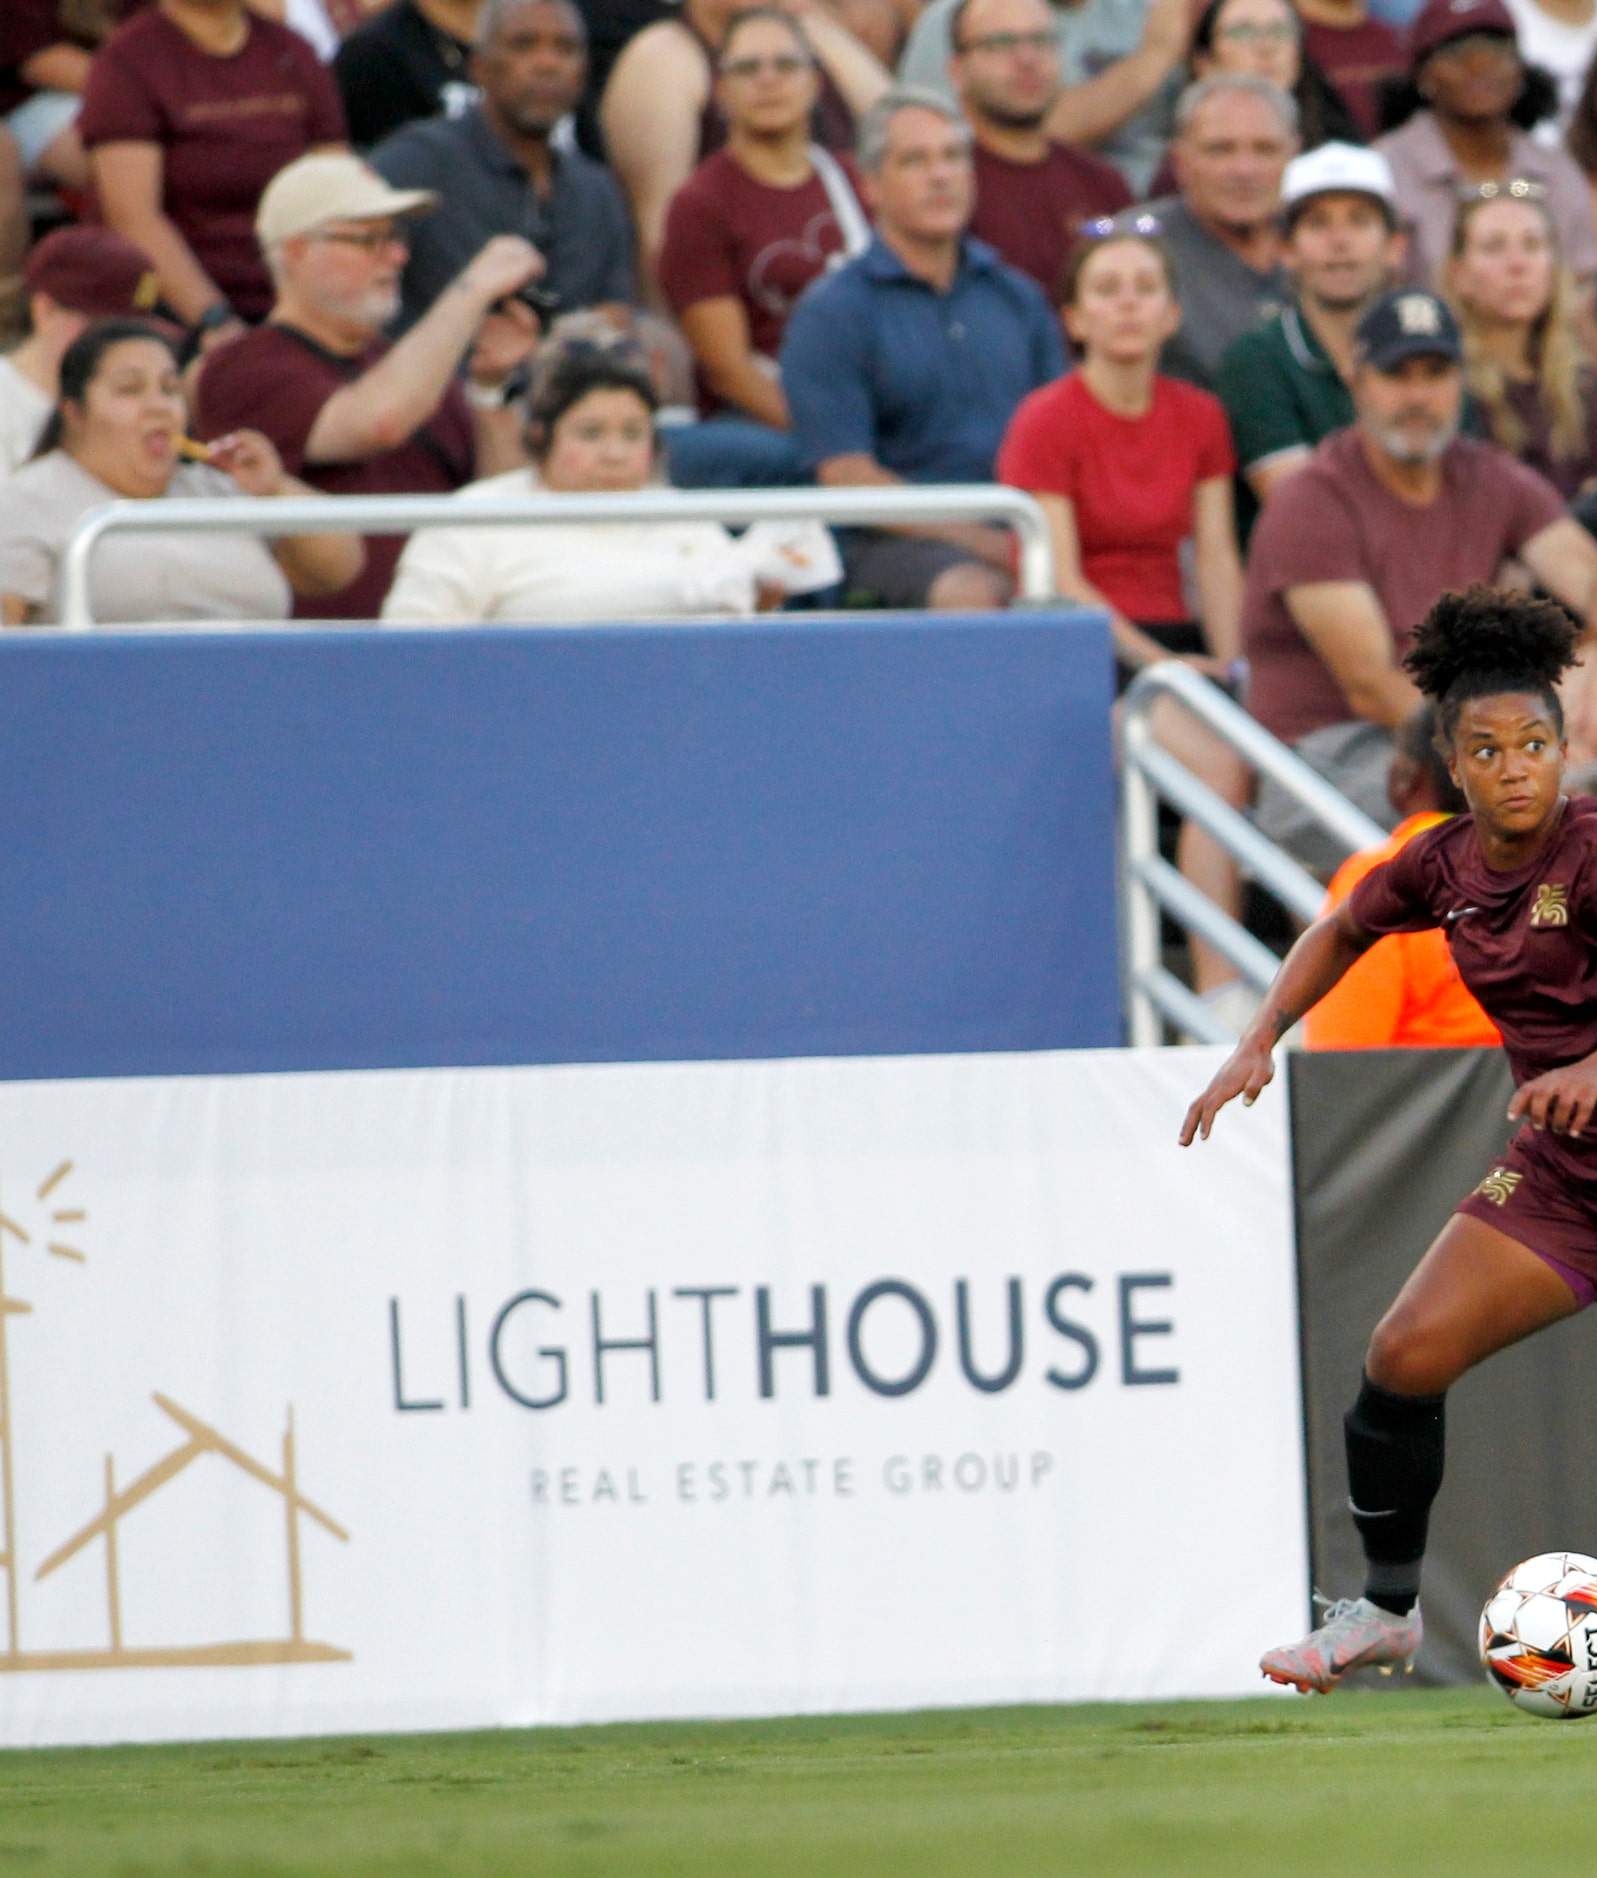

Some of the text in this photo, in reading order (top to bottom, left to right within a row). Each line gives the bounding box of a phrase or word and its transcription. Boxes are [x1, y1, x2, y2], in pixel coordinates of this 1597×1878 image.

[388, 1271, 1180, 1411] LIGHTHOUSE
[529, 1450, 1057, 1505] REAL ESTATE GROUP
